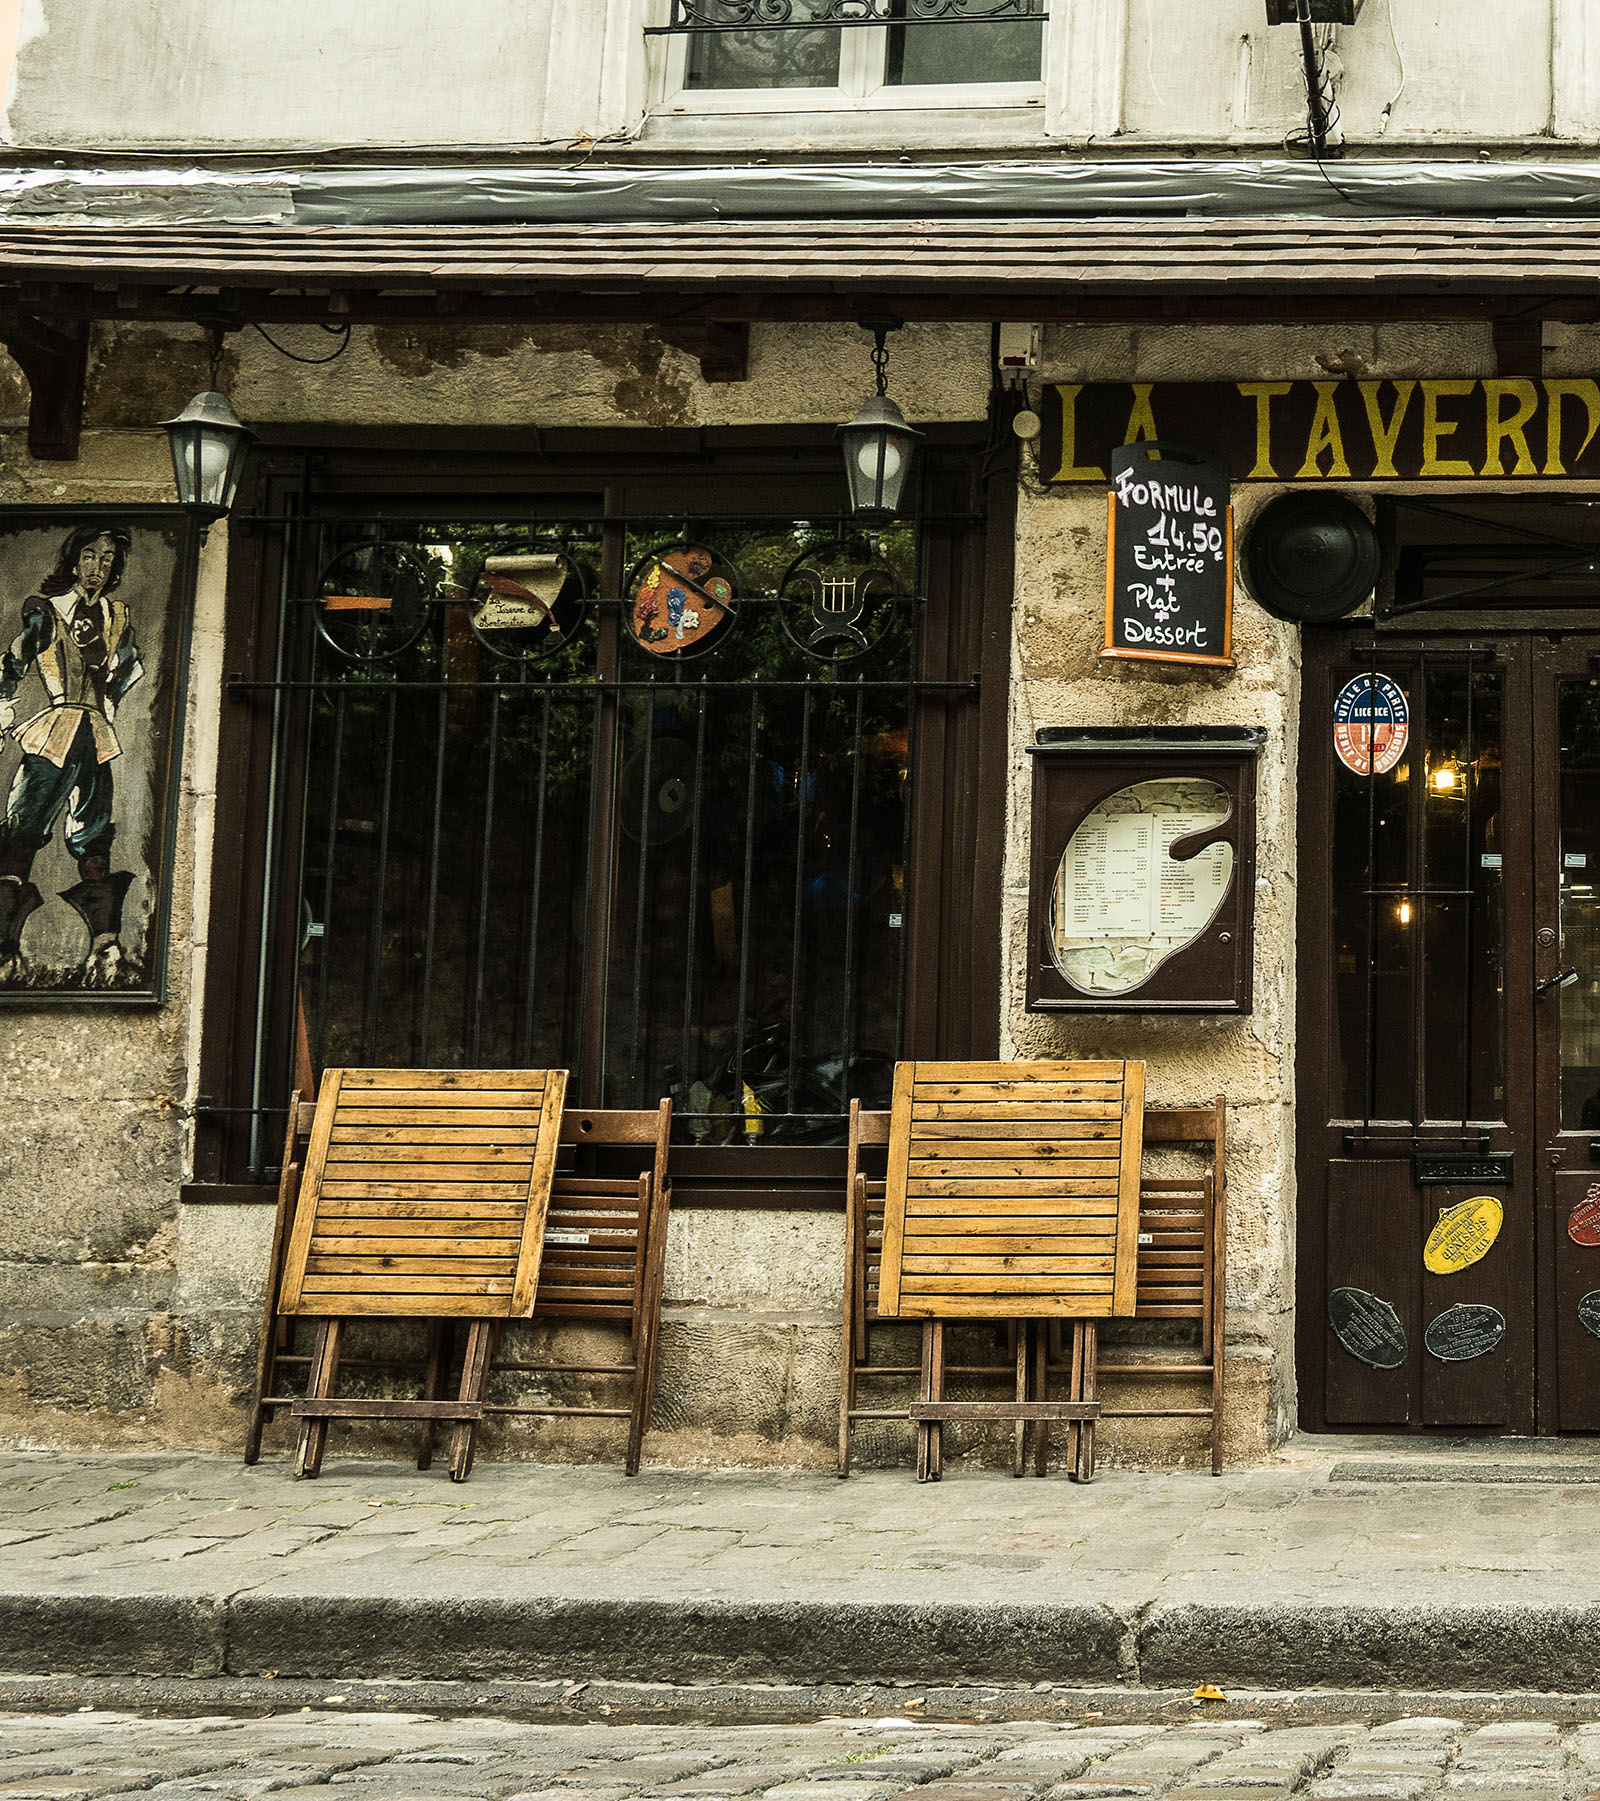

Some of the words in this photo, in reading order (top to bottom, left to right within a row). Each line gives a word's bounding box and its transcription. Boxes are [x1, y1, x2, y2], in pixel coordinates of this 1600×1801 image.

[1051, 384, 1164, 481] LA
[1133, 545, 1206, 574] Entrée
[1126, 582, 1181, 613] Plat
[1123, 617, 1208, 647] Dessert
[1338, 684, 1361, 717] VILLE
[1381, 683, 1405, 717] PARIS
